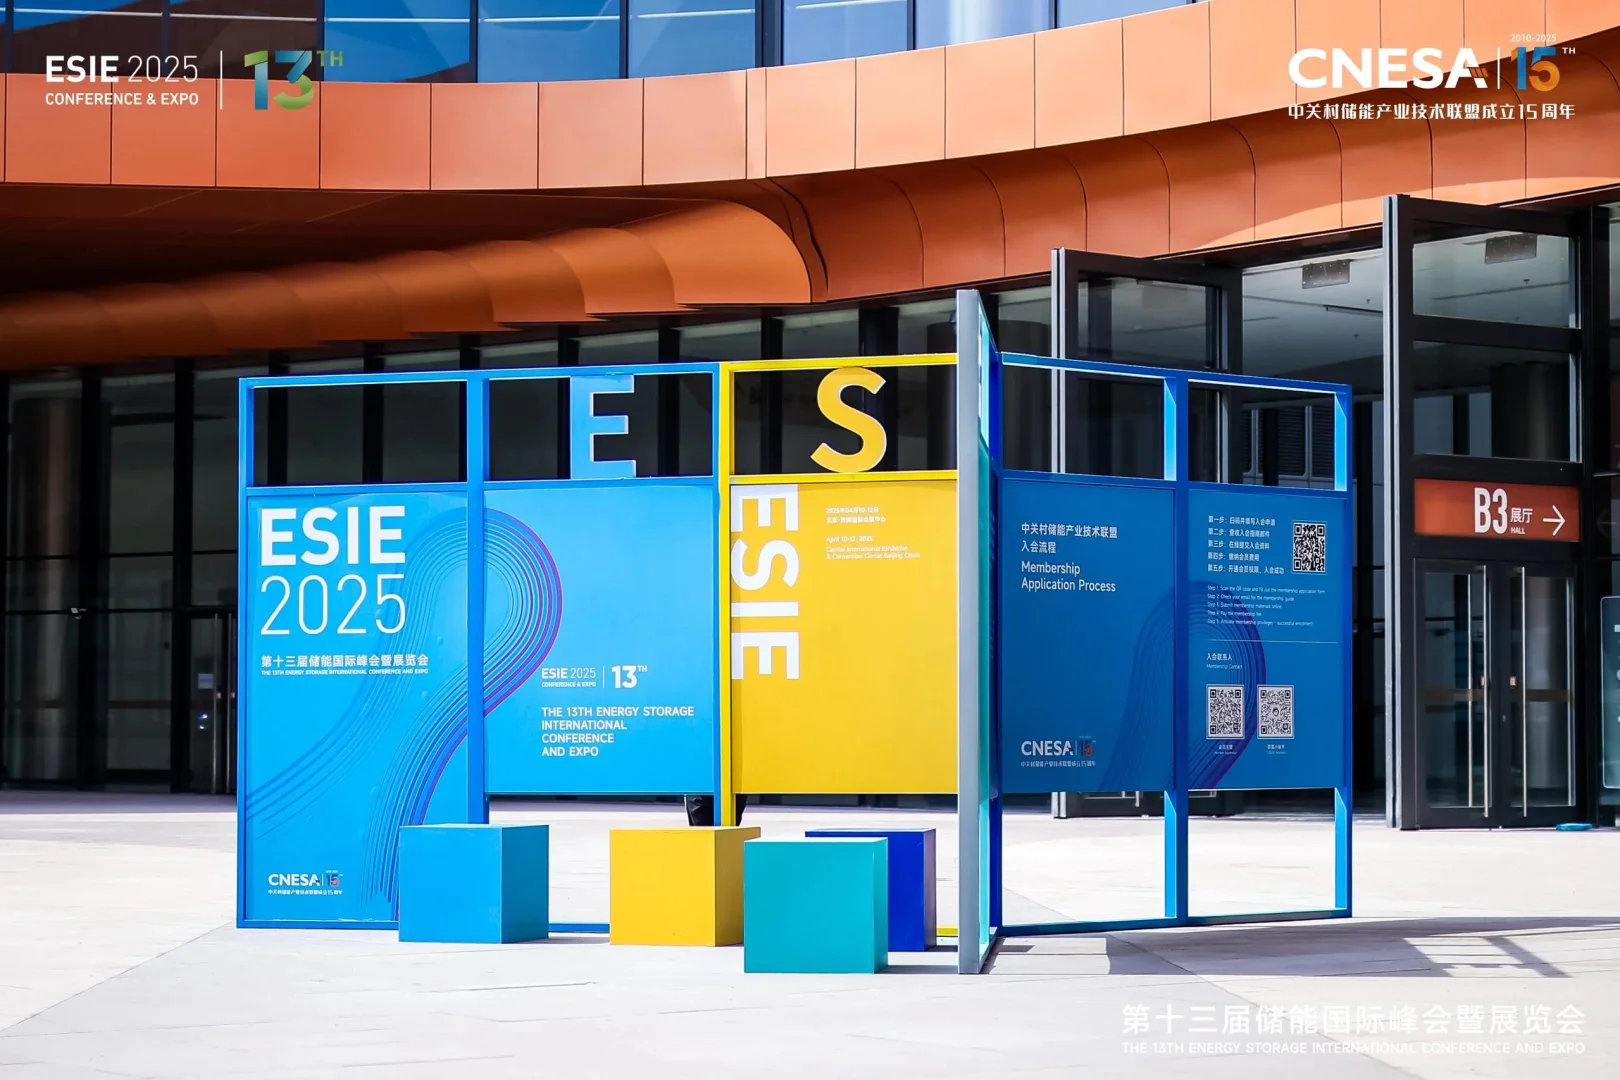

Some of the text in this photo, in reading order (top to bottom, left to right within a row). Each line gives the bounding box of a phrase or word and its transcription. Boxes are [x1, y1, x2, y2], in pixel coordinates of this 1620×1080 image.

[570, 366, 888, 479] E S
[1474, 487, 1533, 534] B3 展厅
[261, 505, 406, 566] ESIE
[1021, 522, 1117, 538] 中关村储能产业技术联盟
[1021, 540, 1056, 553] 入会流程
[1022, 561, 1080, 577] Membership
[731, 484, 800, 680] ESIE
[1022, 577, 1116, 592] Application Process
[260, 574, 406, 635] 2025
[261, 654, 428, 668] 第十三届储能国际峰会暨展览会
[541, 668, 568, 679] ESIE
[570, 668, 596, 679] 2025
[541, 706, 694, 717] THE 13TH ENERGY STORAGE
[542, 720, 627, 730] INTERNATIONAL
[542, 733, 614, 744] CONFERENCE
[542, 746, 598, 757] AND EXPO
[1021, 740, 1073, 756] CNESA
[268, 874, 320, 886] CNESA
